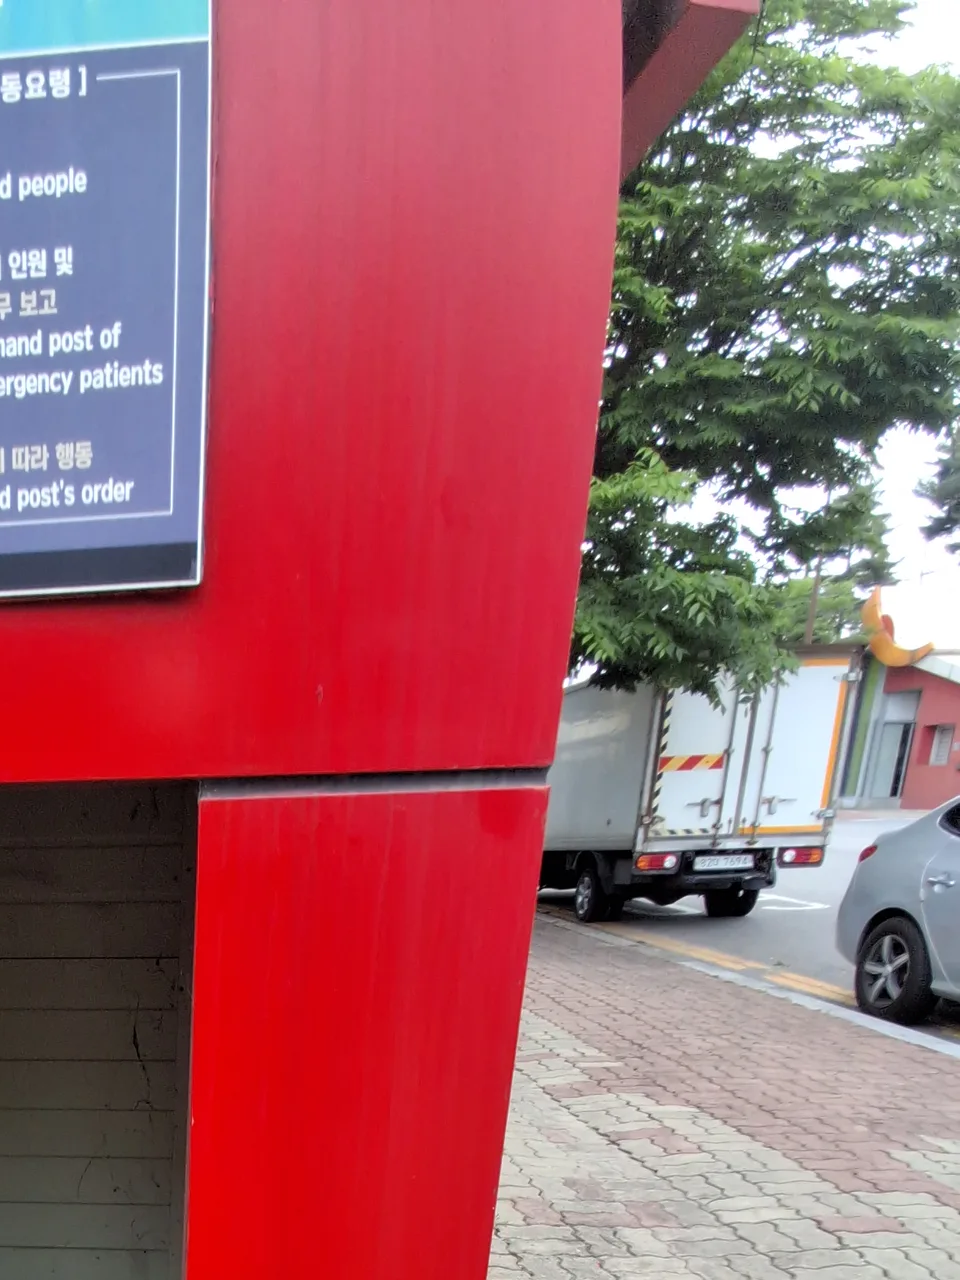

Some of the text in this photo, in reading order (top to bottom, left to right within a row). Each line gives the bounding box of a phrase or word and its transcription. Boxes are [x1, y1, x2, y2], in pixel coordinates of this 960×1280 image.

[18, 166, 87, 201] people
[8, 248, 47, 279] 인원
[53, 246, 74, 276] 및
[19, 289, 58, 317] 보고
[49, 325, 93, 357] post
[100, 322, 122, 349] of
[79, 359, 163, 394] patients
[11, 443, 49, 472] 따라
[56, 440, 94, 471] 행동
[18, 479, 75, 512] post's
[82, 477, 134, 504] order
